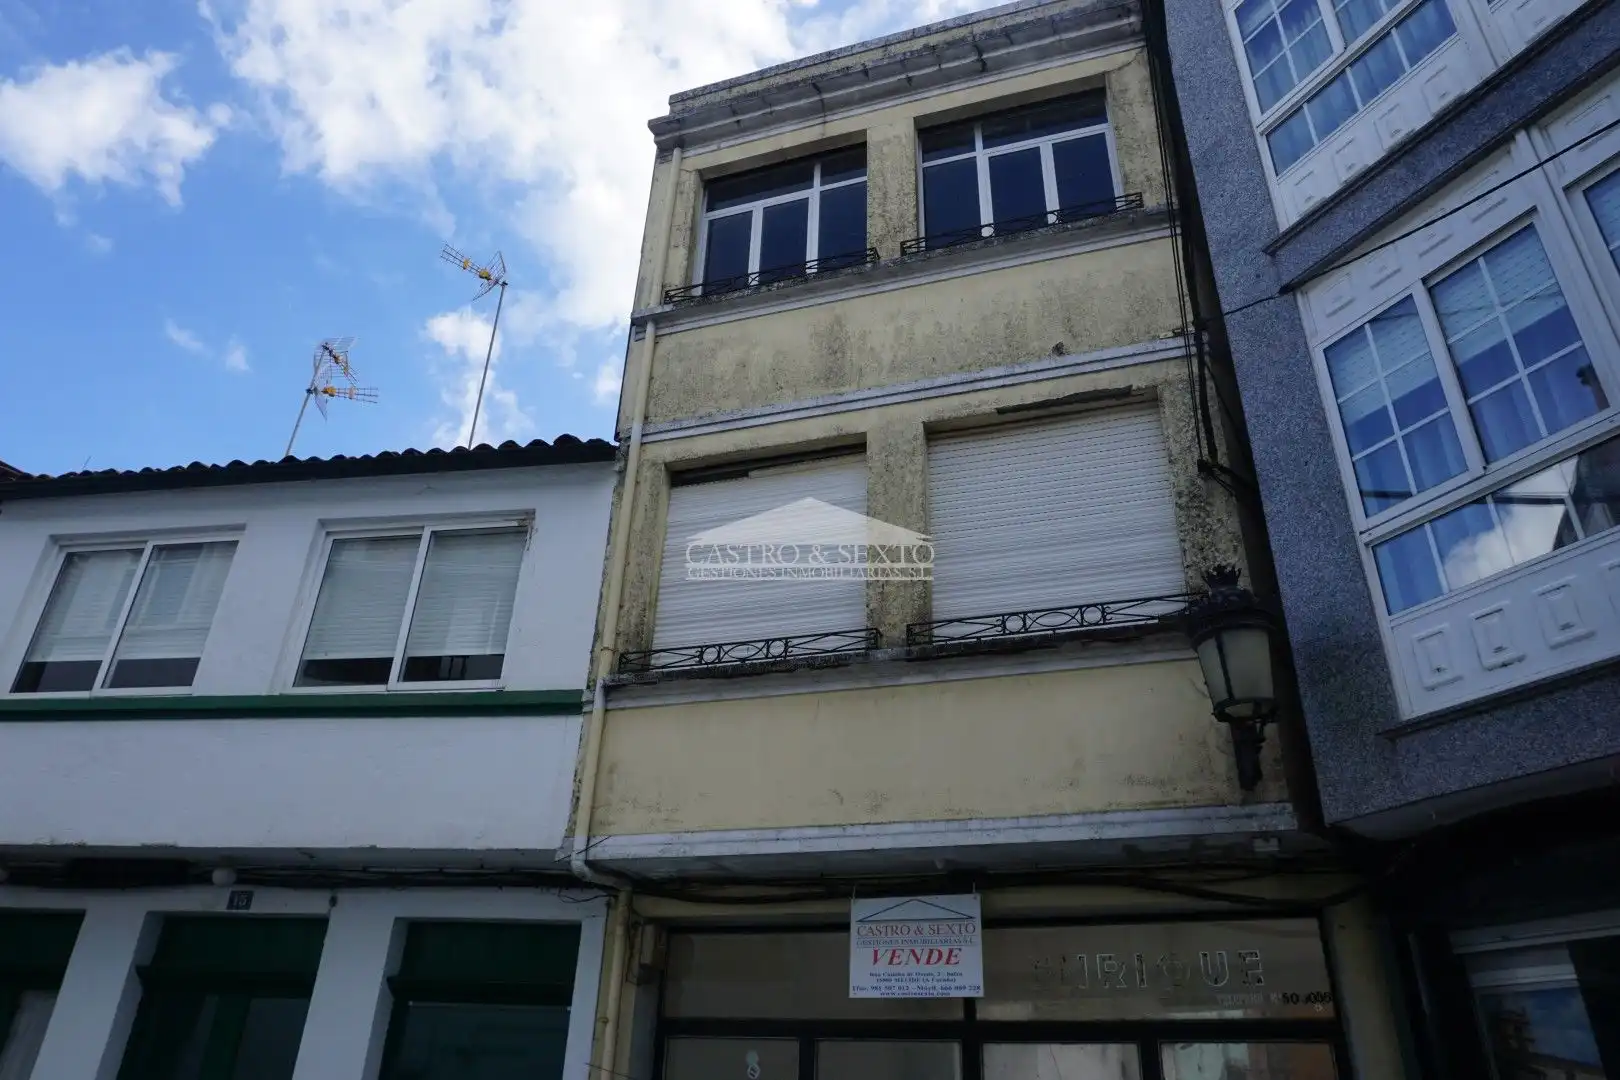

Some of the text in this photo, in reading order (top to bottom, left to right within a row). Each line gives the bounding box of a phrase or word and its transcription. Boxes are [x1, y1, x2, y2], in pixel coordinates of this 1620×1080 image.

[857, 922, 976, 937] CASTRO & SEXTO
[872, 947, 962, 966] VENDE
